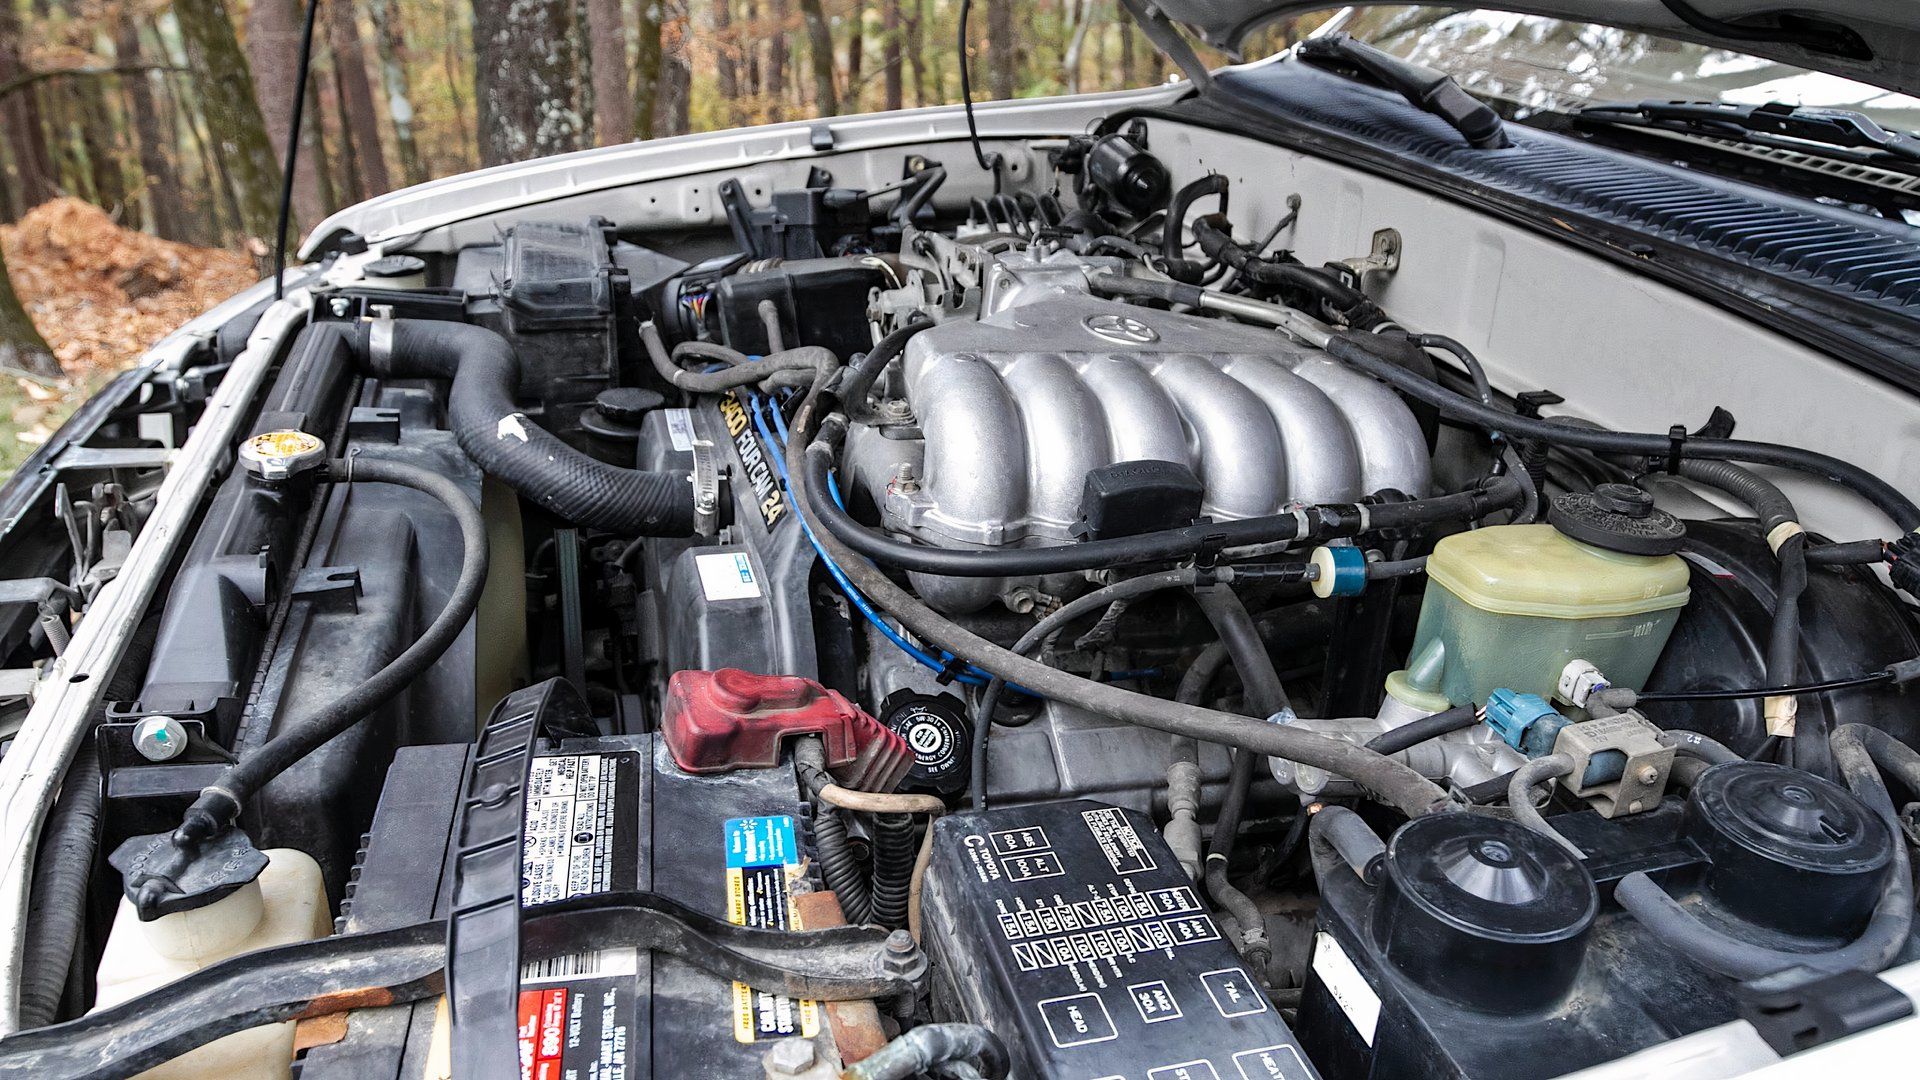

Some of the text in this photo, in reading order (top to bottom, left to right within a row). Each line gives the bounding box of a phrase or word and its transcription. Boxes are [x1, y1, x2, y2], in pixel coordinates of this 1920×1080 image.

[720, 391, 784, 526] 3400 FOUR CAM 24
[558, 758, 566, 776] MEDICAL
[580, 774, 588, 784] OPEN
[584, 802, 594, 831] INSTRUCTIONS
[1003, 834, 1018, 850] 60A
[1021, 832, 1036, 847] ABS
[1121, 826, 1144, 850] NOTICE
[581, 848, 590, 868] CHILDREN
[980, 848, 1001, 880] TOYOTA
[1034, 858, 1049, 873] ALT
[1016, 859, 1032, 877] 100A
[1106, 883, 1119, 897] STOP
[1116, 900, 1131, 918] 10A
[1134, 897, 1149, 915] 15A
[1159, 893, 1176, 910] 50A
[1172, 890, 1190, 910] HEATER
[734, 899, 742, 925] AL-MART
[1041, 912, 1057, 930] 15A
[1060, 908, 1075, 928] 7.5A
[1096, 902, 1114, 922] 7.5A
[1003, 918, 1019, 936] 15A
[1022, 915, 1037, 933] 15A
[1177, 922, 1193, 939] 40A
[1189, 920, 1207, 937] AM1
[1113, 932, 1129, 951] 10A
[1151, 927, 1167, 945] 10A
[1057, 943, 1072, 960] 10A
[1076, 940, 1090, 957] 10A
[1094, 937, 1110, 956] 10A
[1151, 989, 1171, 1012] AM2
[1224, 981, 1244, 1004] TAIL
[1138, 992, 1157, 1014] 30A
[569, 994, 584, 1048] 12-VOLT Battery
[601, 1006, 616, 1039] STORES,
[1067, 1005, 1088, 1034] HEAD
